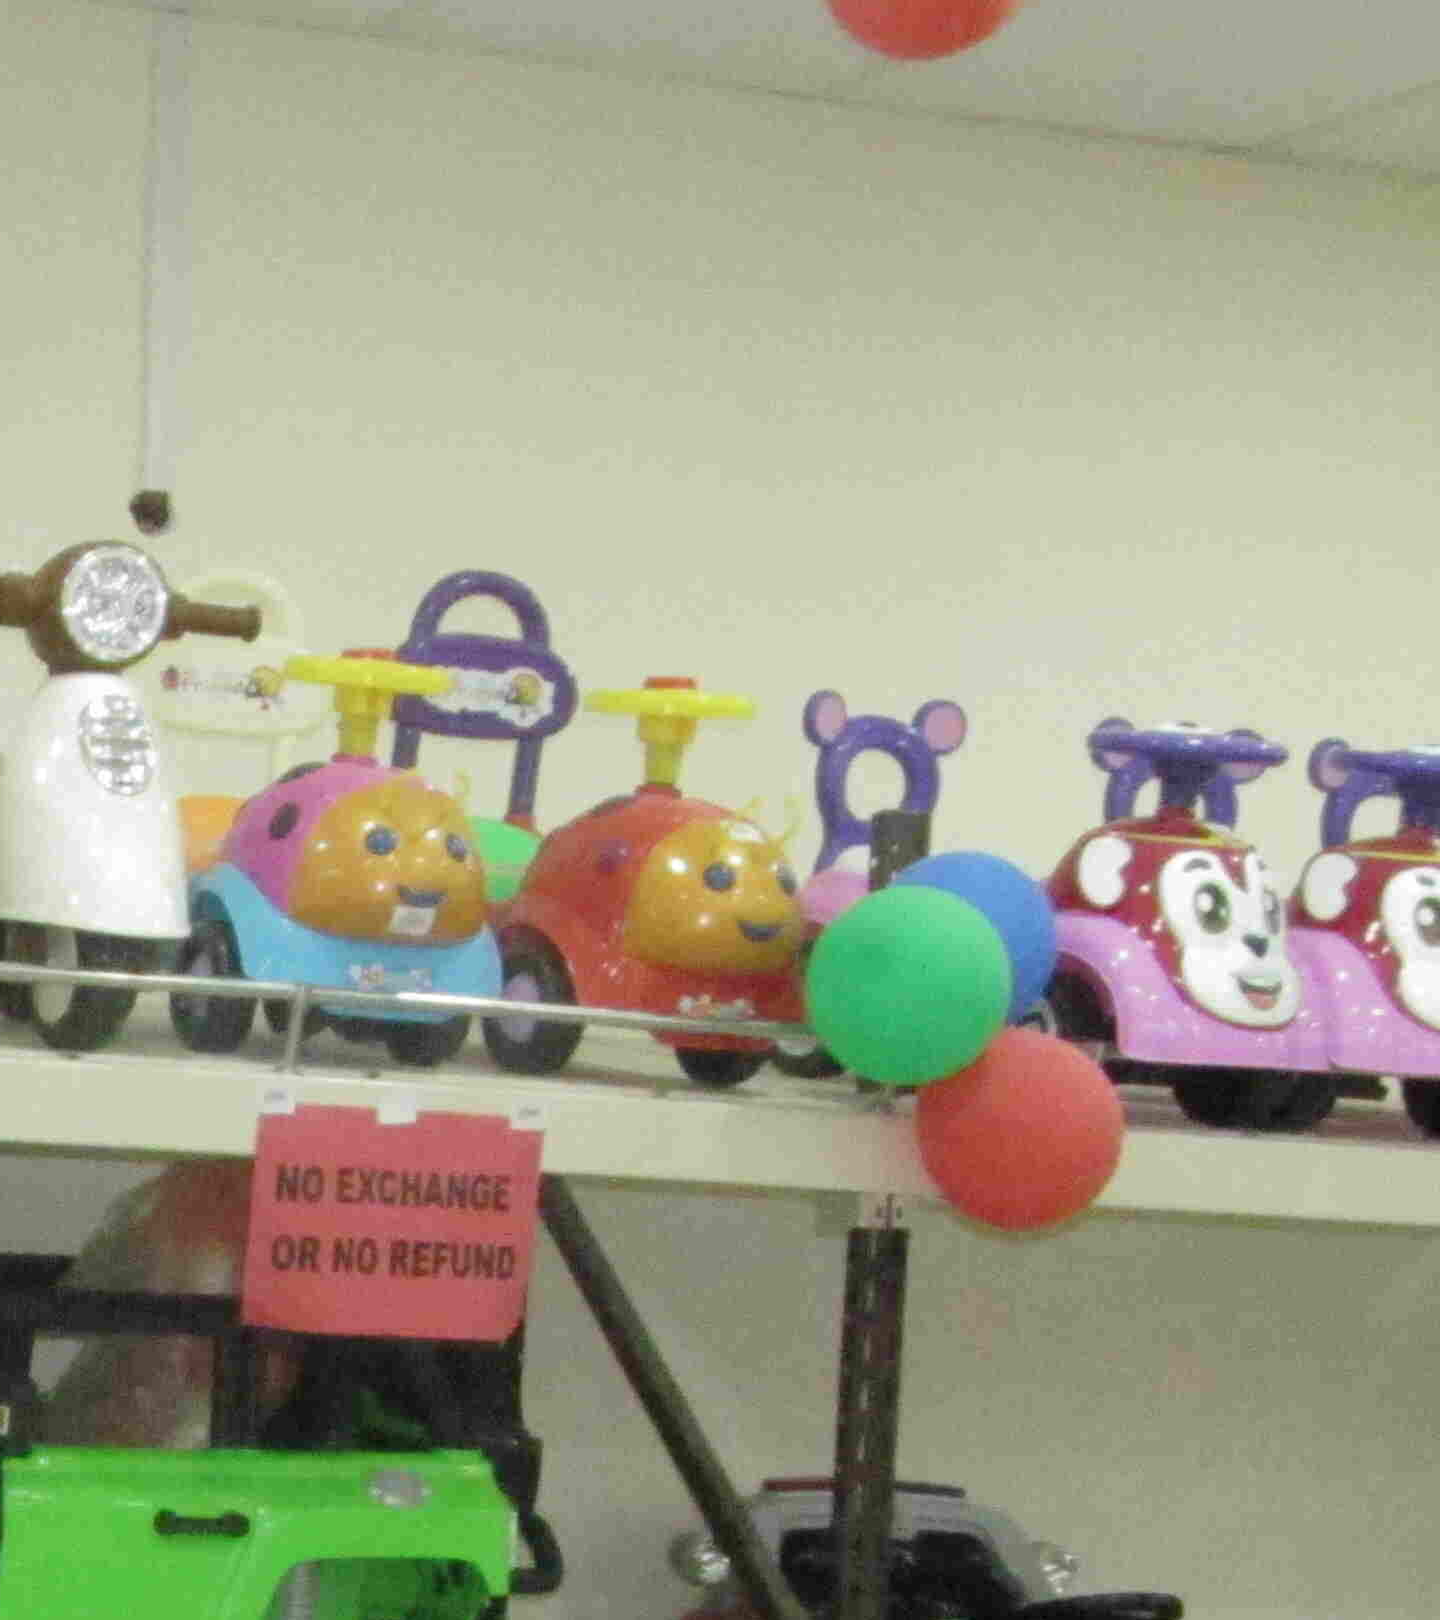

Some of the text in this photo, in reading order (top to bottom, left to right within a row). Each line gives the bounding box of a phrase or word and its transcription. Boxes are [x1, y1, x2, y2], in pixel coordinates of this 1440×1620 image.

[274, 1164, 512, 1213] NO EXCHANGE
[271, 1234, 516, 1280] OR NO REFUND
